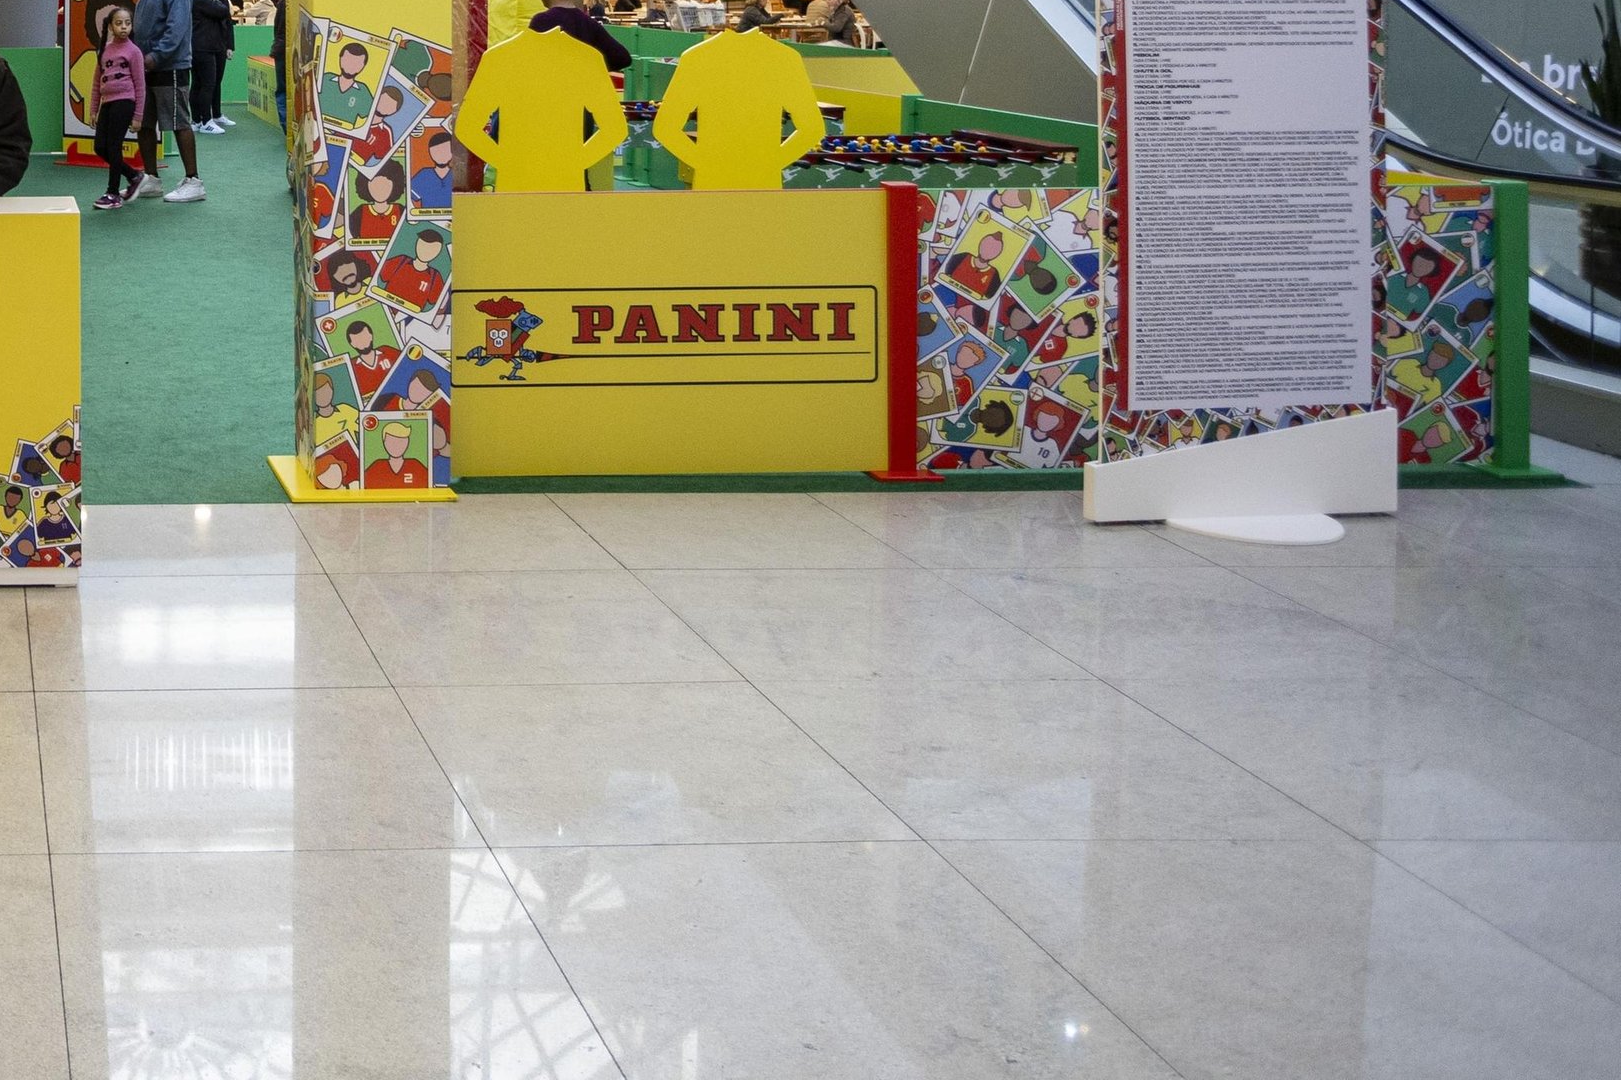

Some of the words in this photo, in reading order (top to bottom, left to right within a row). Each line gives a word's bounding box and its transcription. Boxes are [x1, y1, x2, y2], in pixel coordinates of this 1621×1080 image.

[348, 97, 356, 107] 9
[1491, 111, 1566, 153] Ótica
[391, 215, 396, 226] 8
[419, 281, 428, 292] 11
[572, 302, 856, 344] PANINI
[379, 359, 391, 370] 10
[337, 420, 348, 430] 7
[1037, 446, 1049, 459] 10
[404, 474, 413, 483] 2
